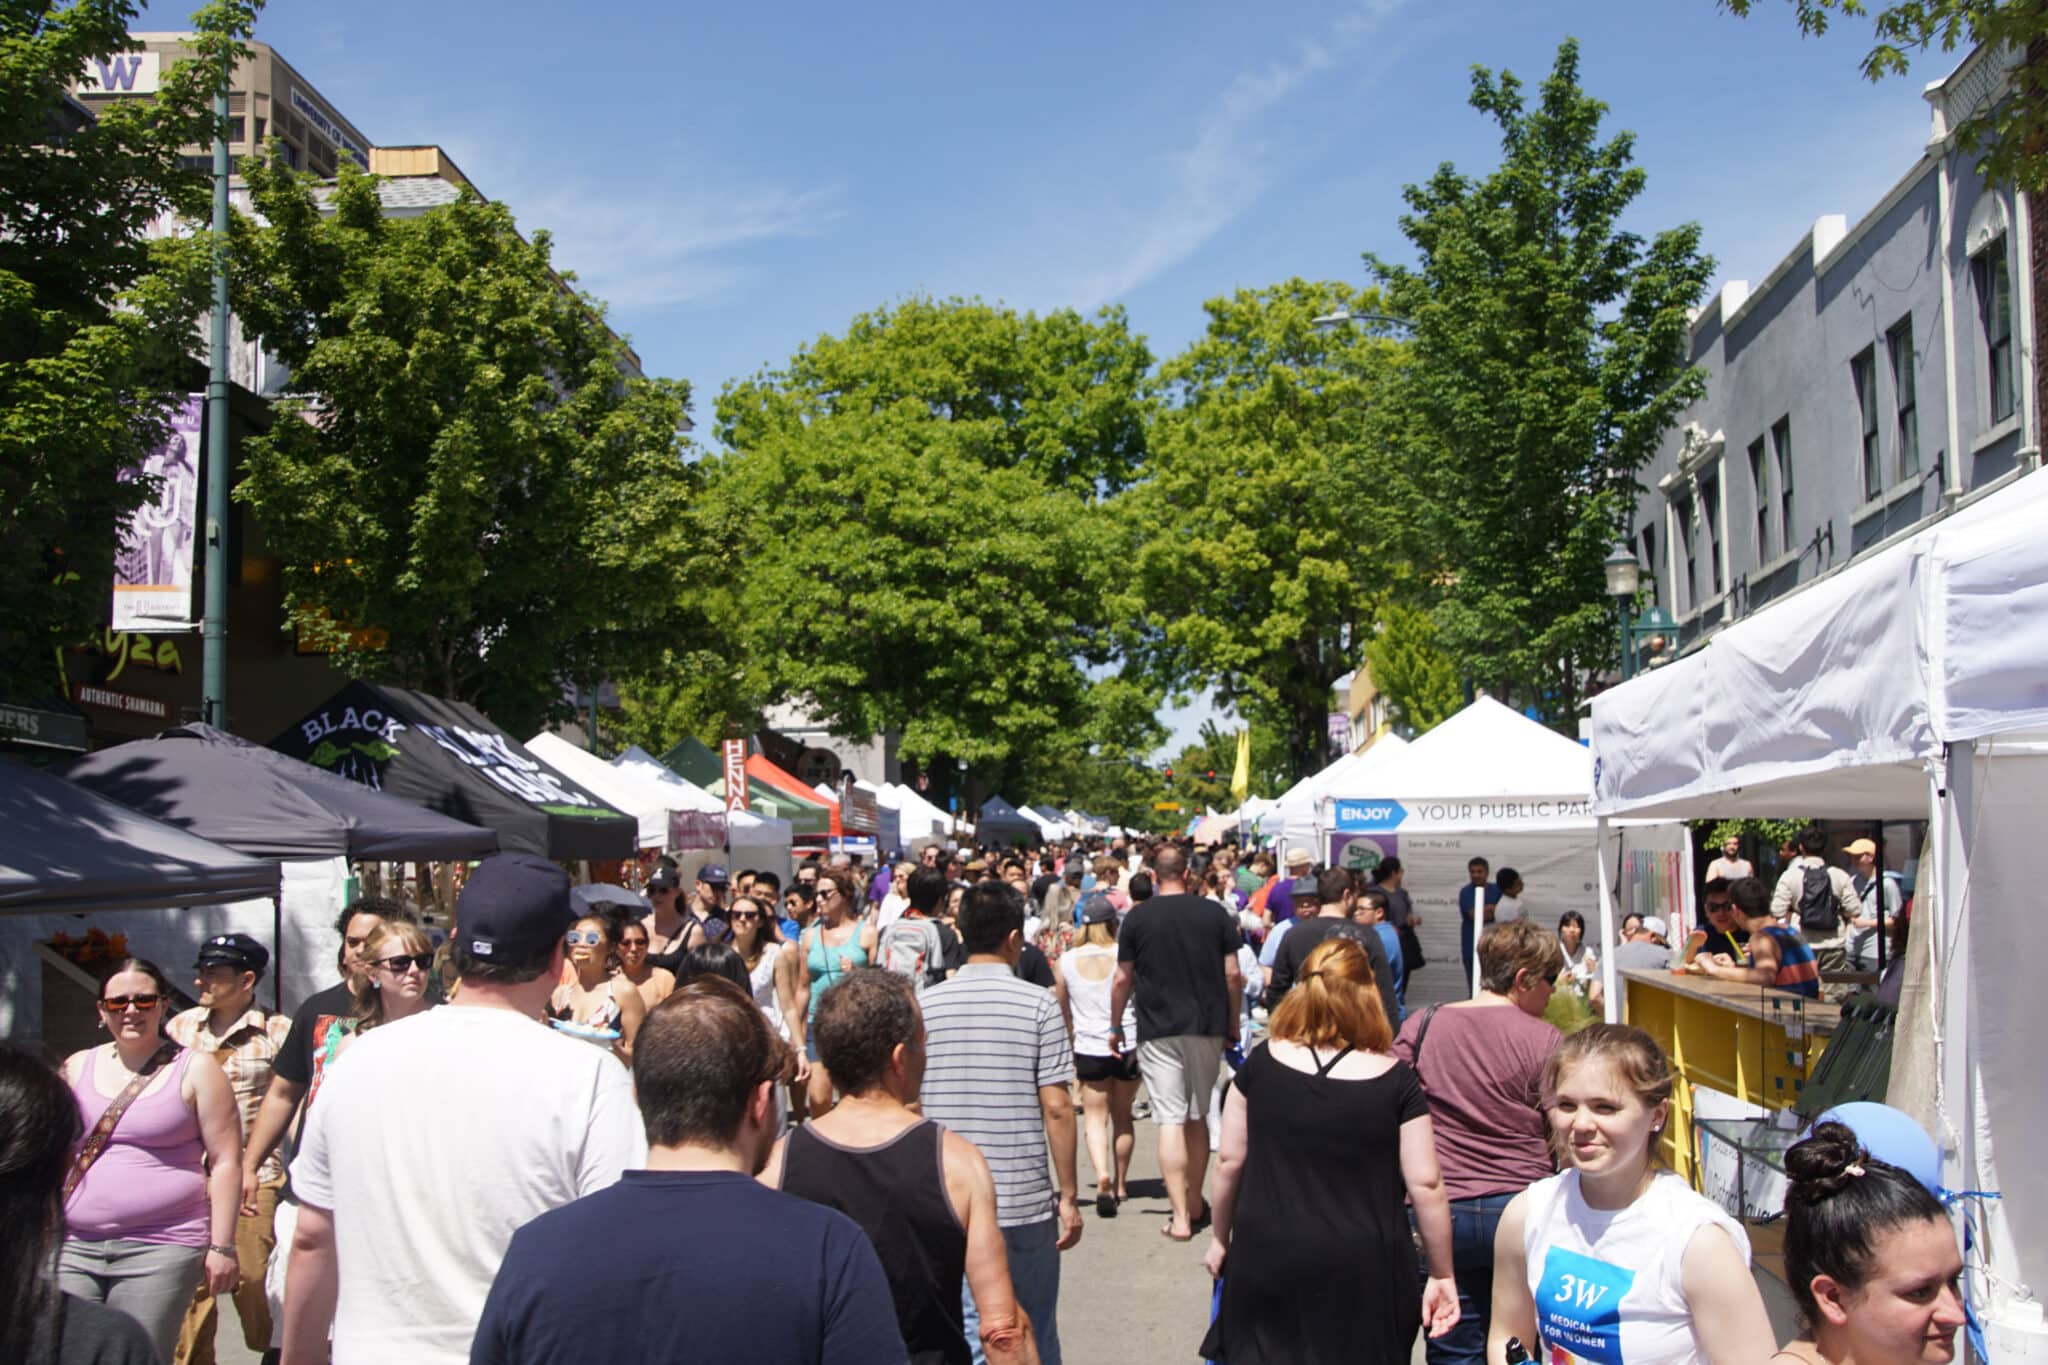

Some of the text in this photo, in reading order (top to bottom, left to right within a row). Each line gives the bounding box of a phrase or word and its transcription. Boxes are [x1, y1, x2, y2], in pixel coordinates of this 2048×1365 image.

[95, 56, 142, 91] W
[80, 686, 166, 718] AUTHENTIC SHAWARMA
[302, 706, 407, 744] BLACK
[726, 739, 746, 811] HENNA
[1341, 807, 1392, 821] ENJOY
[1417, 803, 1473, 821] YOUR
[1479, 802, 1551, 819] PUBLIC
[1554, 1273, 1609, 1310] 3W
[1544, 1324, 1606, 1349] FOR WOMEN
[1550, 1312, 1592, 1333] MEDICAL
